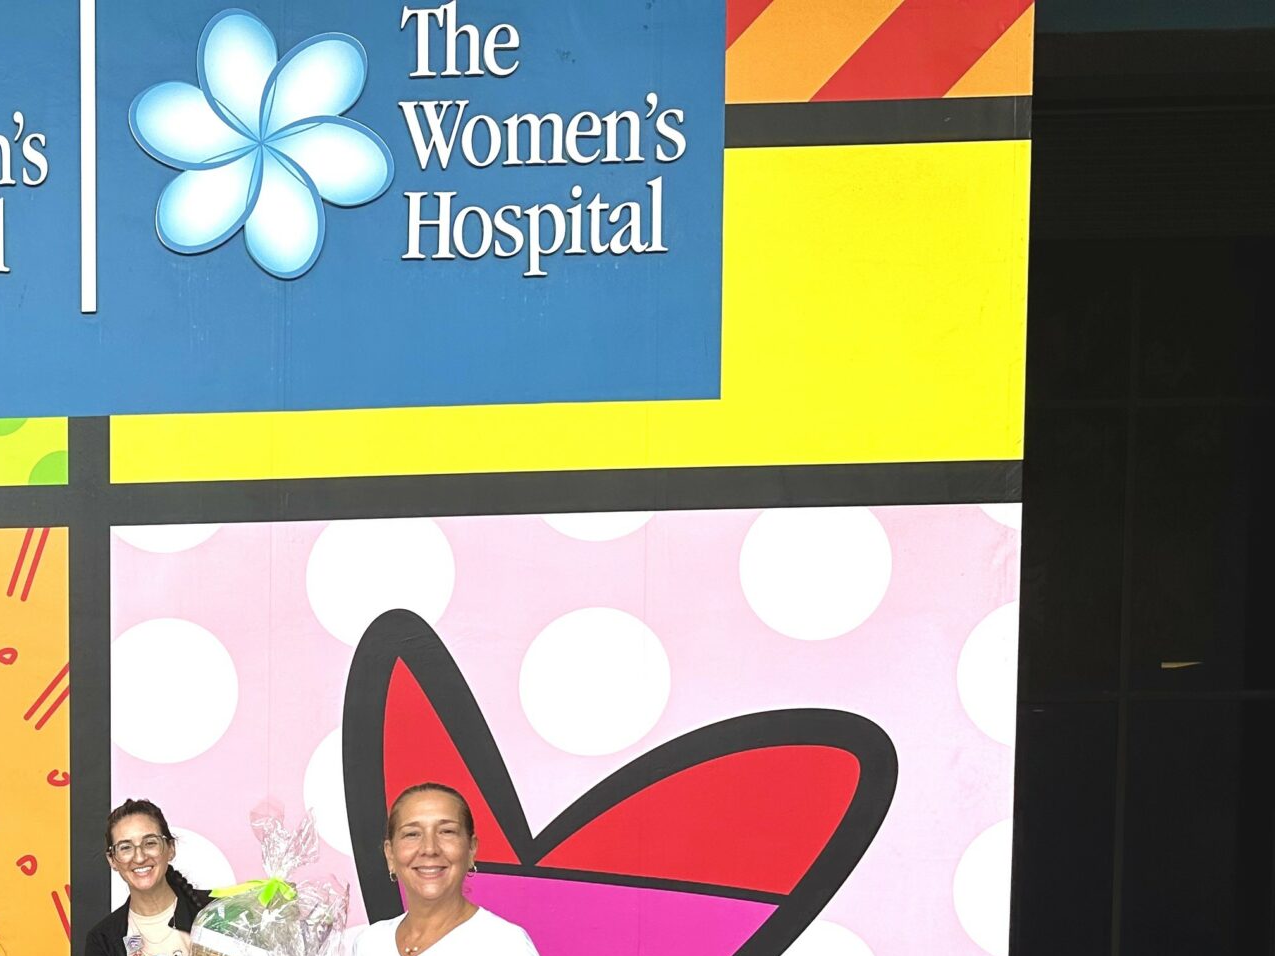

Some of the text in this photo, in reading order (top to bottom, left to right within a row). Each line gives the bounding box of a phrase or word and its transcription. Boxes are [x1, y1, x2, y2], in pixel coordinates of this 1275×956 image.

[401, 0, 521, 79] The
[398, 92, 687, 170] Women's
[401, 176, 669, 278] Hospital
